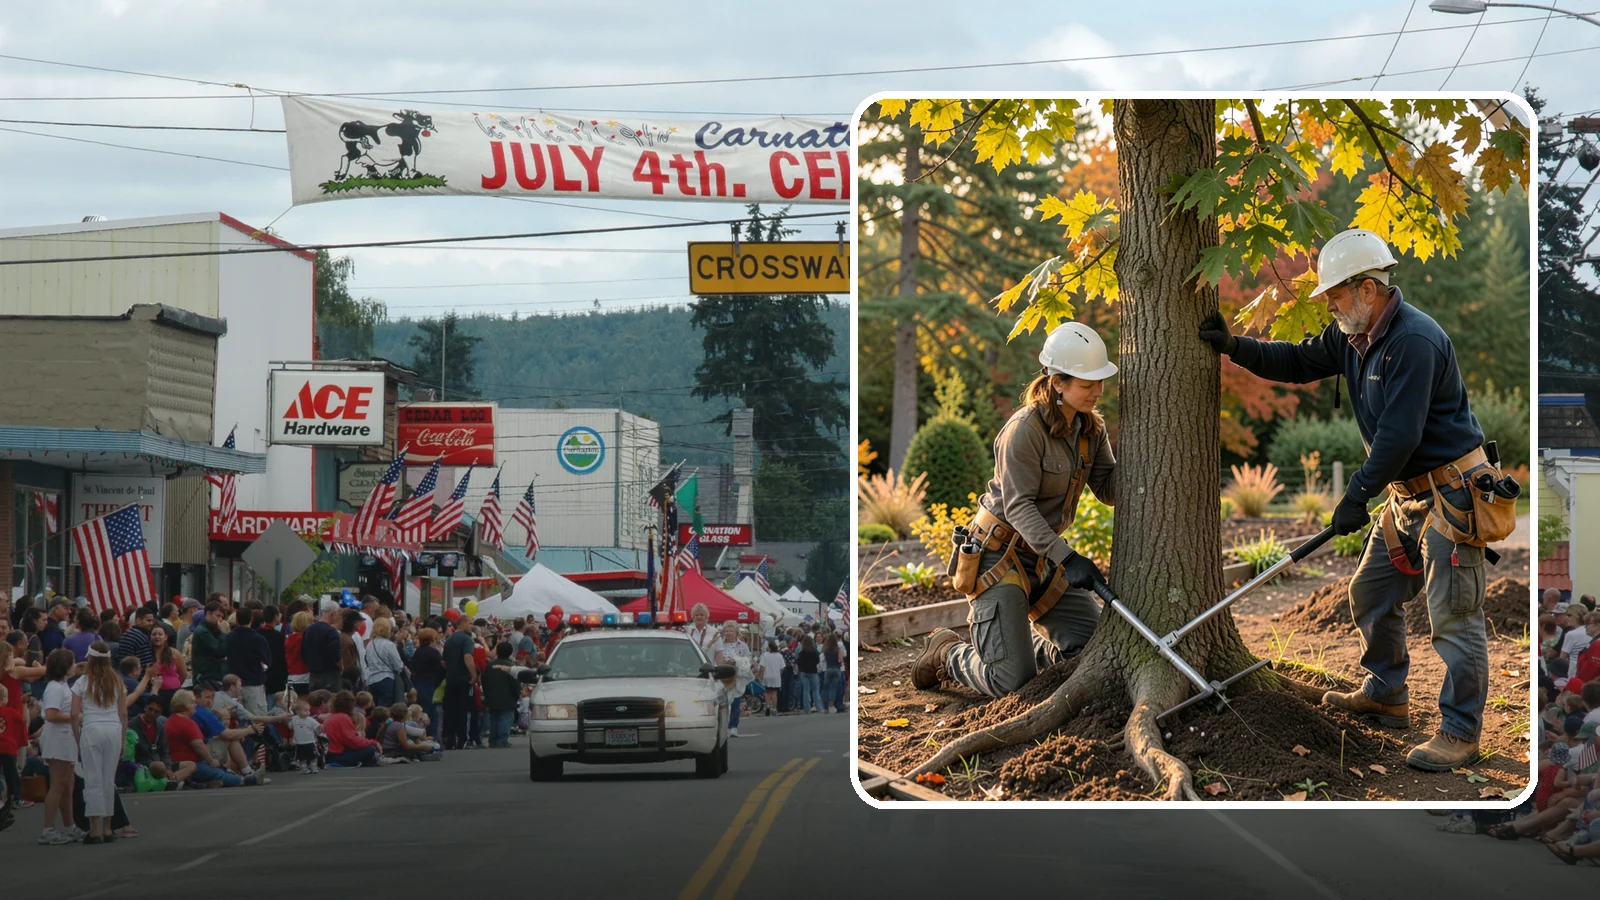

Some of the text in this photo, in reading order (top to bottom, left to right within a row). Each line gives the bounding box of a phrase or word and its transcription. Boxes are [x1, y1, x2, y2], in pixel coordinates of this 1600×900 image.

[481, 141, 604, 192] JULY
[632, 149, 746, 197] 4th.
[697, 254, 850, 280] CROSSWA
[282, 380, 373, 420] ACE
[405, 409, 452, 422] CEDAR
[283, 421, 370, 436] Hardware
[416, 428, 477, 447] Coca-Cola
[83, 484, 155, 495] St. Vincent de Paul
[688, 526, 741, 535] CRNATION
[699, 535, 730, 543] GLASS
